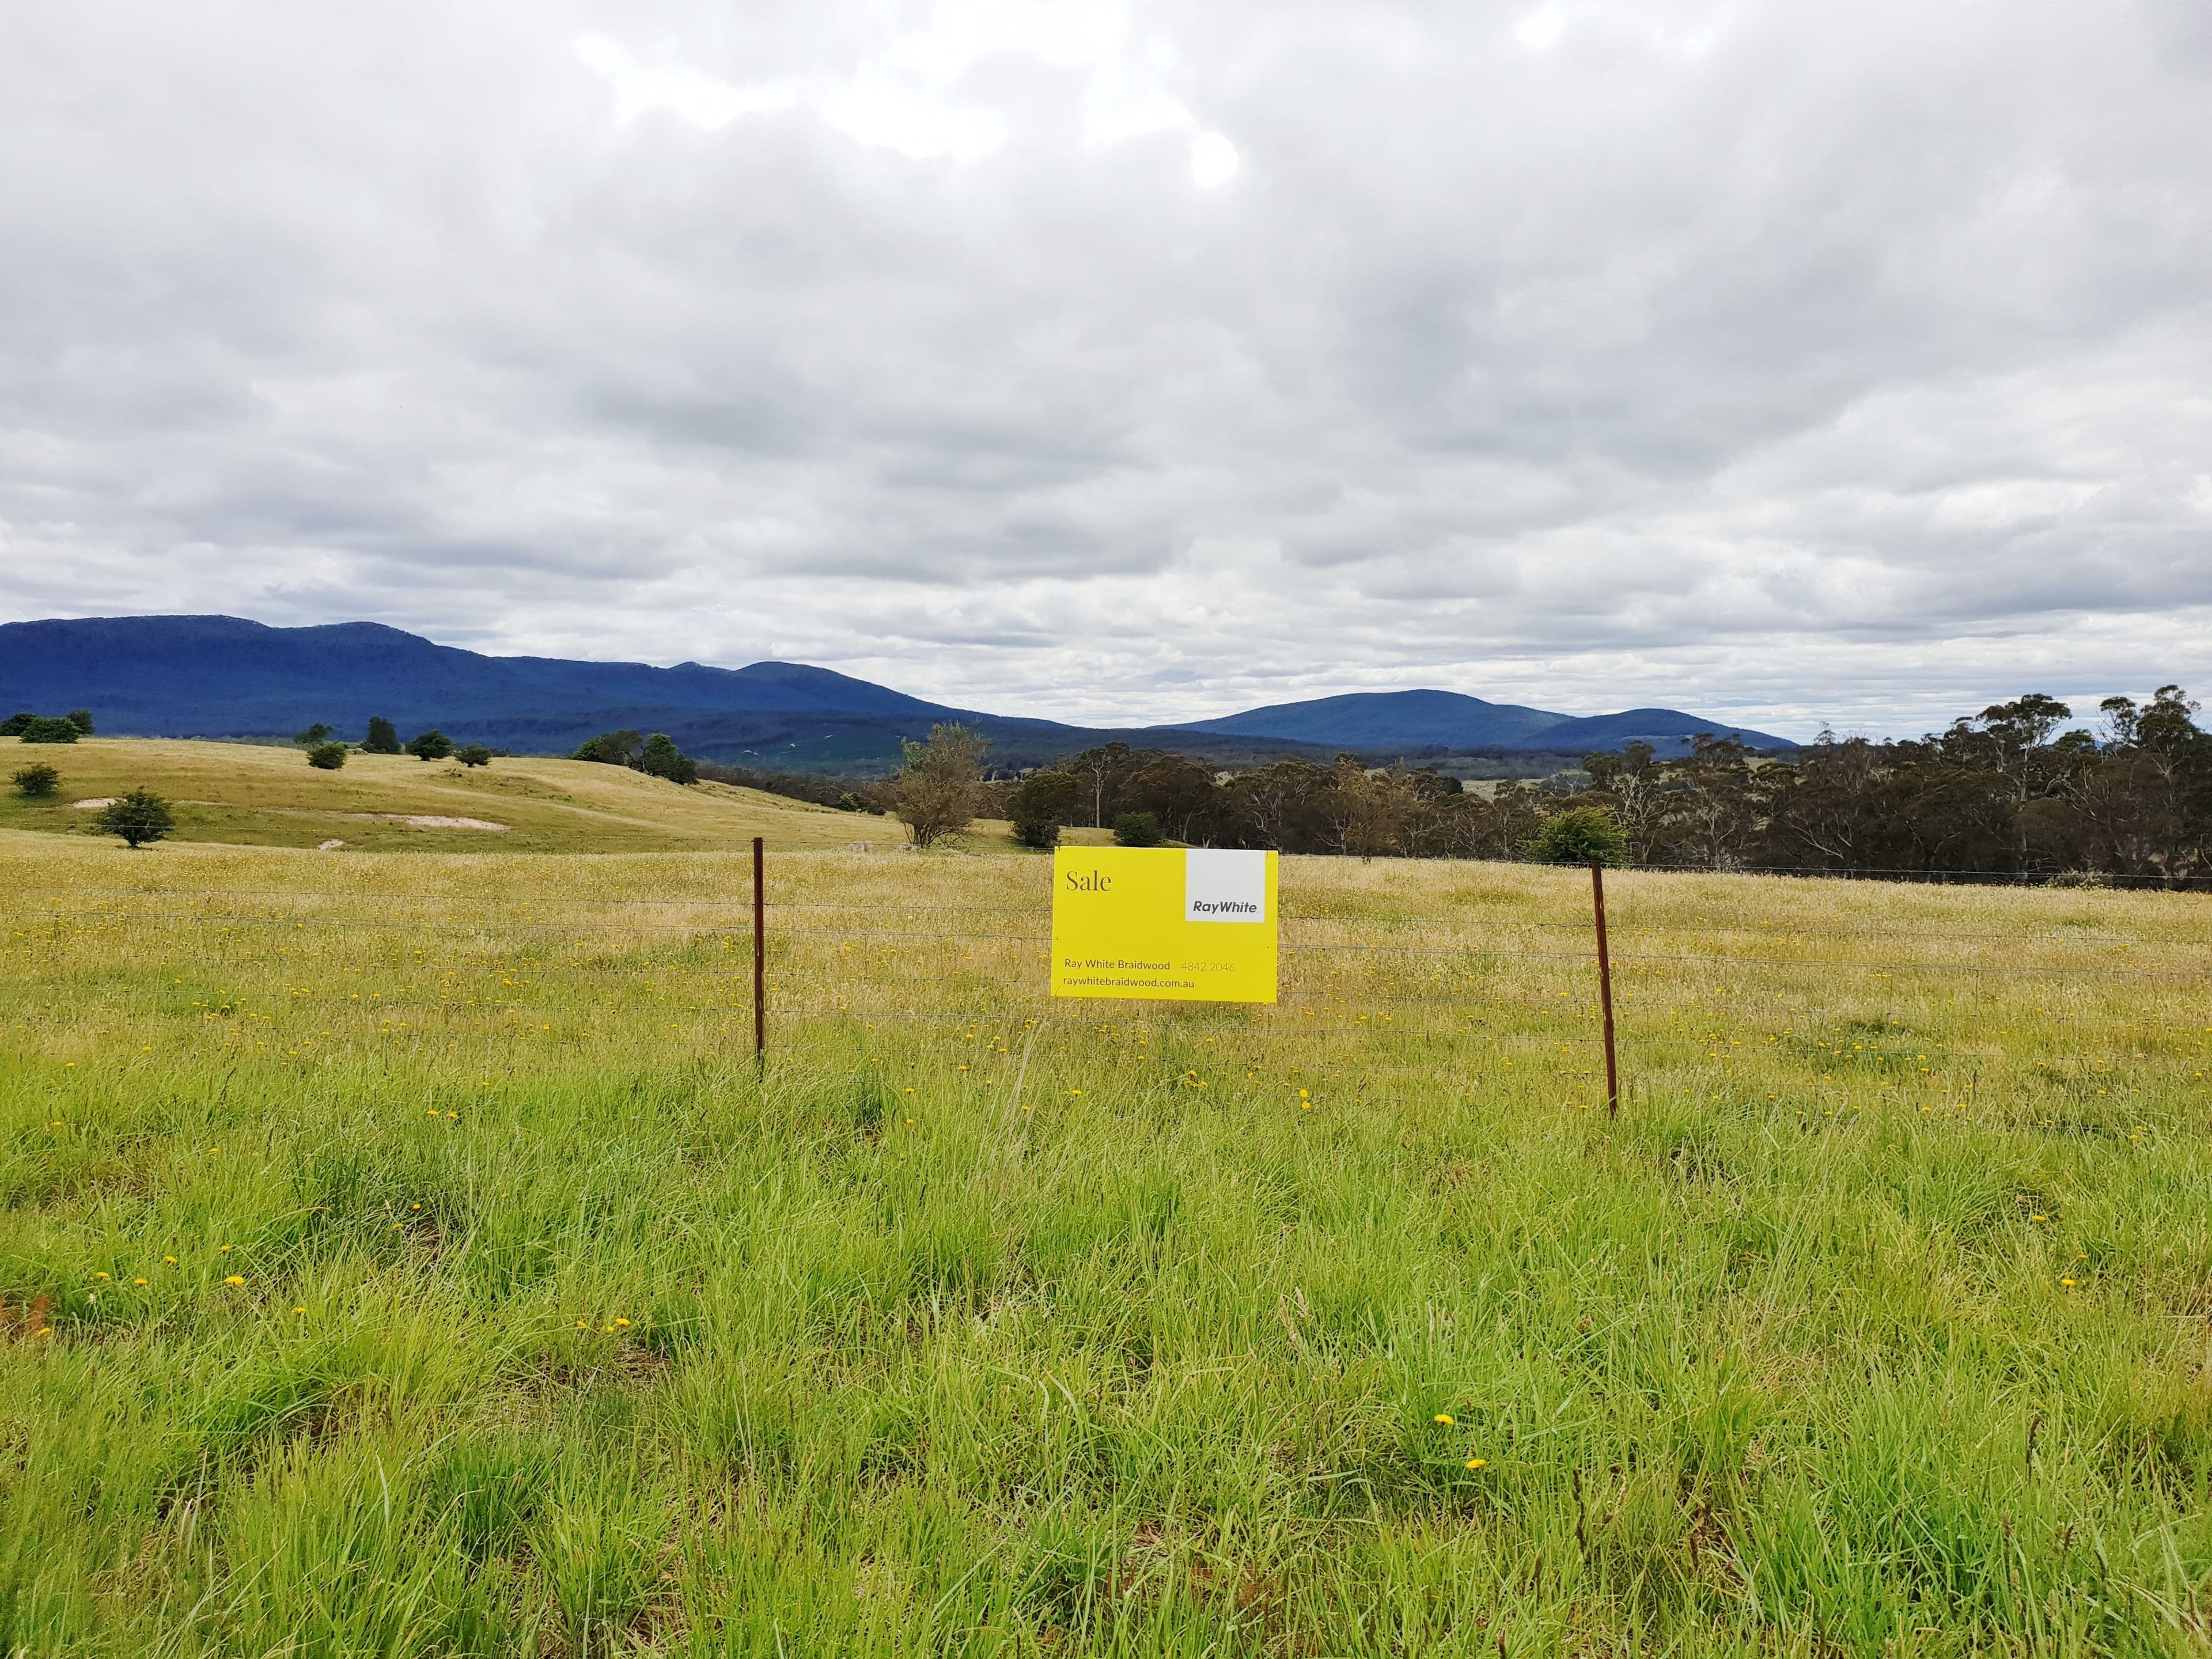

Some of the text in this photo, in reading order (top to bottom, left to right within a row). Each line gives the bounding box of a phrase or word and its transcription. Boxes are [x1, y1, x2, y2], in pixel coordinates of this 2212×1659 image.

[1066, 870, 1112, 891] Sale
[1065, 959, 1235, 972] Ray White Braidwood 4842 2046
[1063, 976, 1194, 988] raywhitebraidwood.com.au
